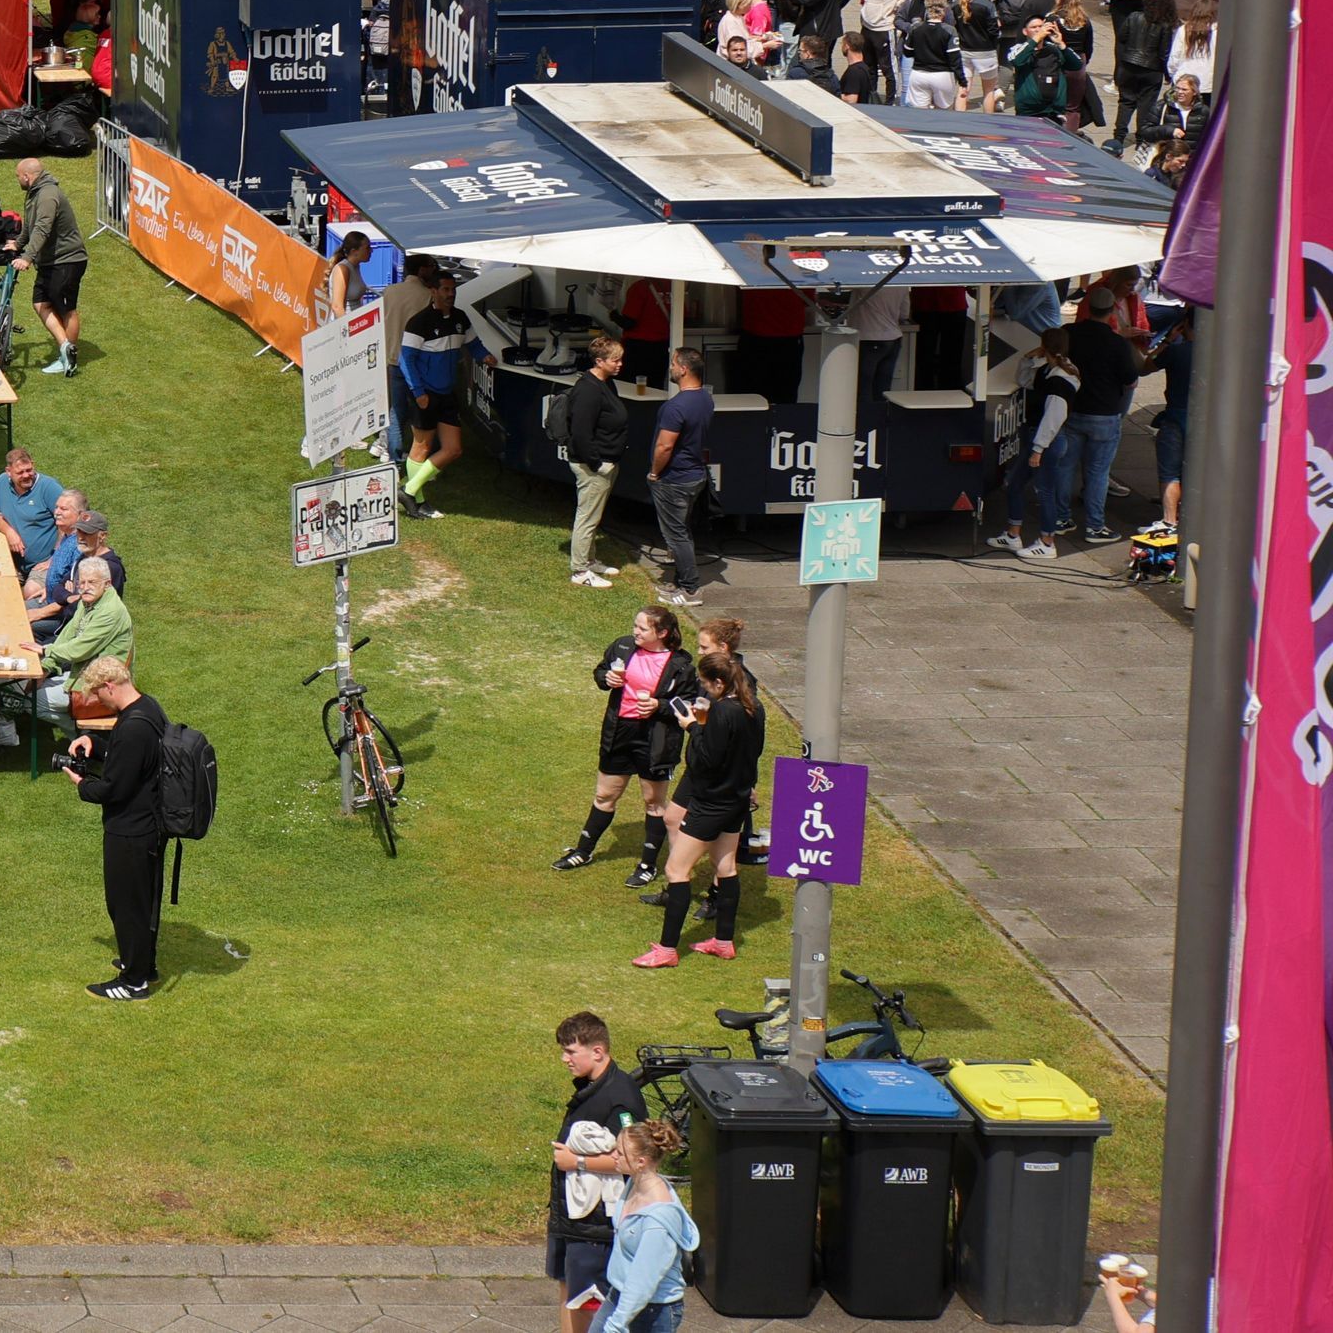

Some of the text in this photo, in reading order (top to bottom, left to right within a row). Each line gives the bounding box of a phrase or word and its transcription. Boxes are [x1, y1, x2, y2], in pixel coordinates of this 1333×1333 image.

[252, 22, 346, 62] Gaffel
[144, 55, 165, 104] Kölsch
[270, 60, 327, 83] Kölsch
[715, 78, 764, 136] Gaffel Kölsch
[439, 176, 498, 204] Kölsch
[477, 161, 582, 205] Gaffel
[944, 202, 984, 213] gaffel.de
[172, 210, 186, 235] Ein
[186, 221, 206, 247] Leben
[221, 223, 258, 282] DAK
[222, 259, 255, 304] Gesundheit
[255, 269, 272, 297] Ein
[272, 280, 293, 309] Leben
[348, 318, 369, 334] Stadt Köln
[308, 362, 341, 388] Sportpark
[770, 427, 883, 471] Gael
[798, 848, 834, 867] WC
[766, 1163, 795, 1177] AWB
[899, 1167, 928, 1182] AWB
